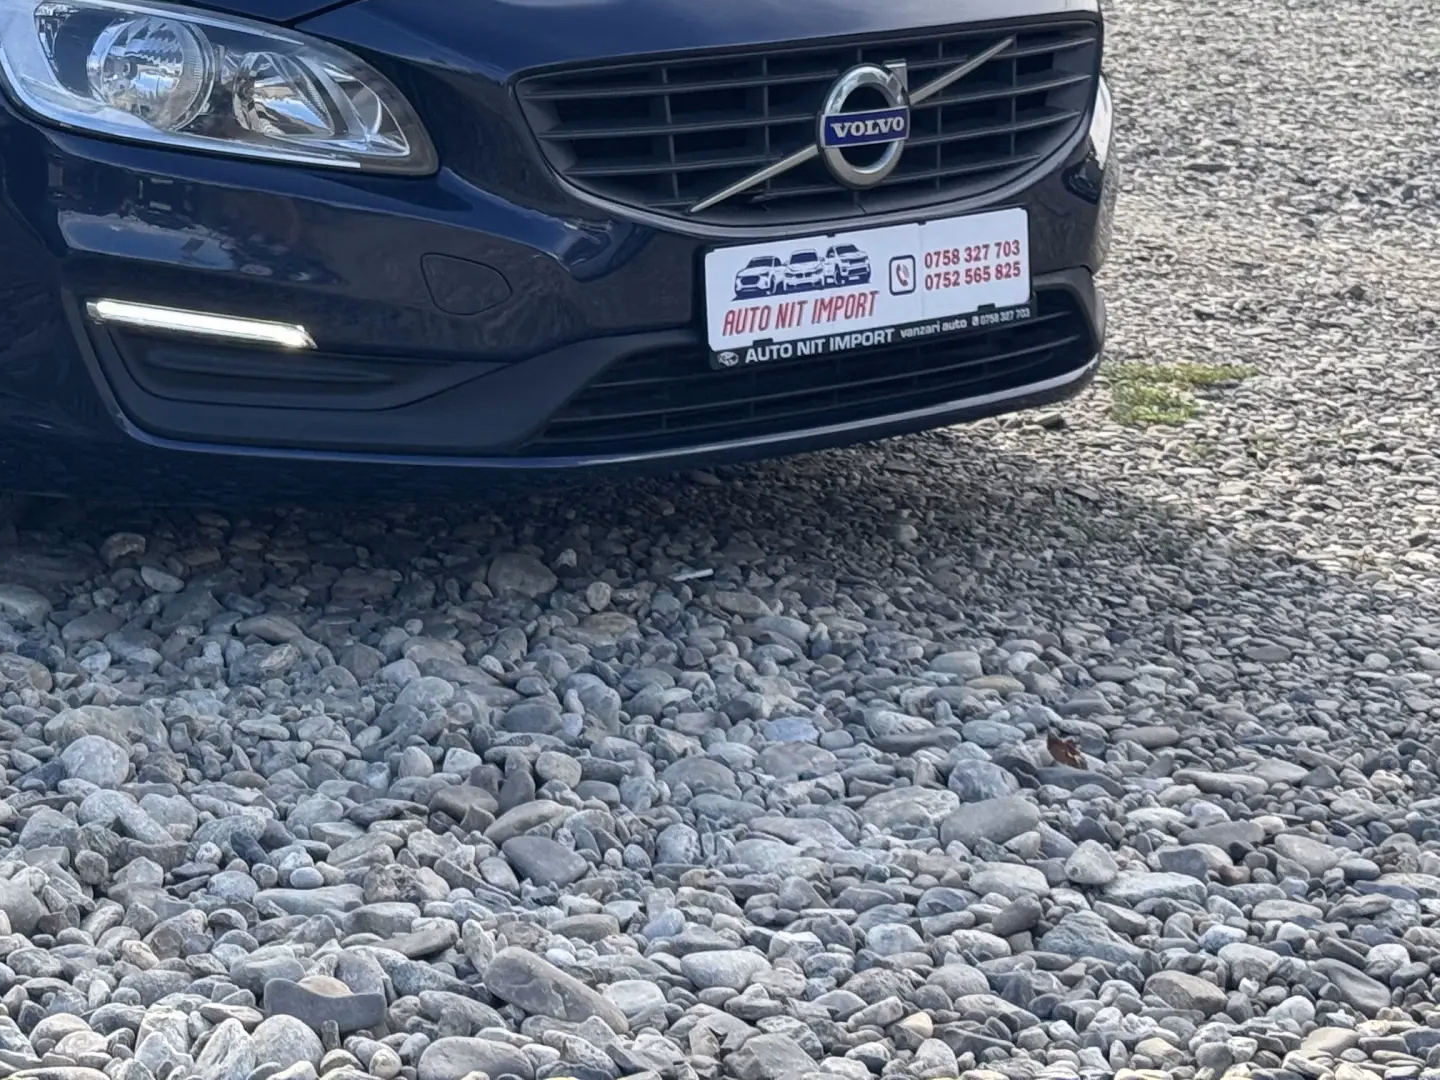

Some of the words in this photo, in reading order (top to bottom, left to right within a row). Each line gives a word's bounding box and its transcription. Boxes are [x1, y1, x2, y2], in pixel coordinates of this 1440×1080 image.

[830, 117, 905, 138] VOLVO
[924, 248, 960, 269] 0758
[964, 243, 990, 263] 327
[994, 239, 1020, 259] 703
[925, 270, 961, 291] 0752
[964, 265, 991, 285] 565
[995, 261, 1021, 281] 825
[722, 305, 772, 337] AUTO
[775, 300, 808, 329] NIT
[811, 290, 880, 325] IMPORT
[744, 343, 793, 364] AUTO
[797, 338, 826, 356] NIT
[829, 328, 895, 352] IMPORT
[900, 321, 940, 338] vanzari
[941, 319, 967, 332] auto
